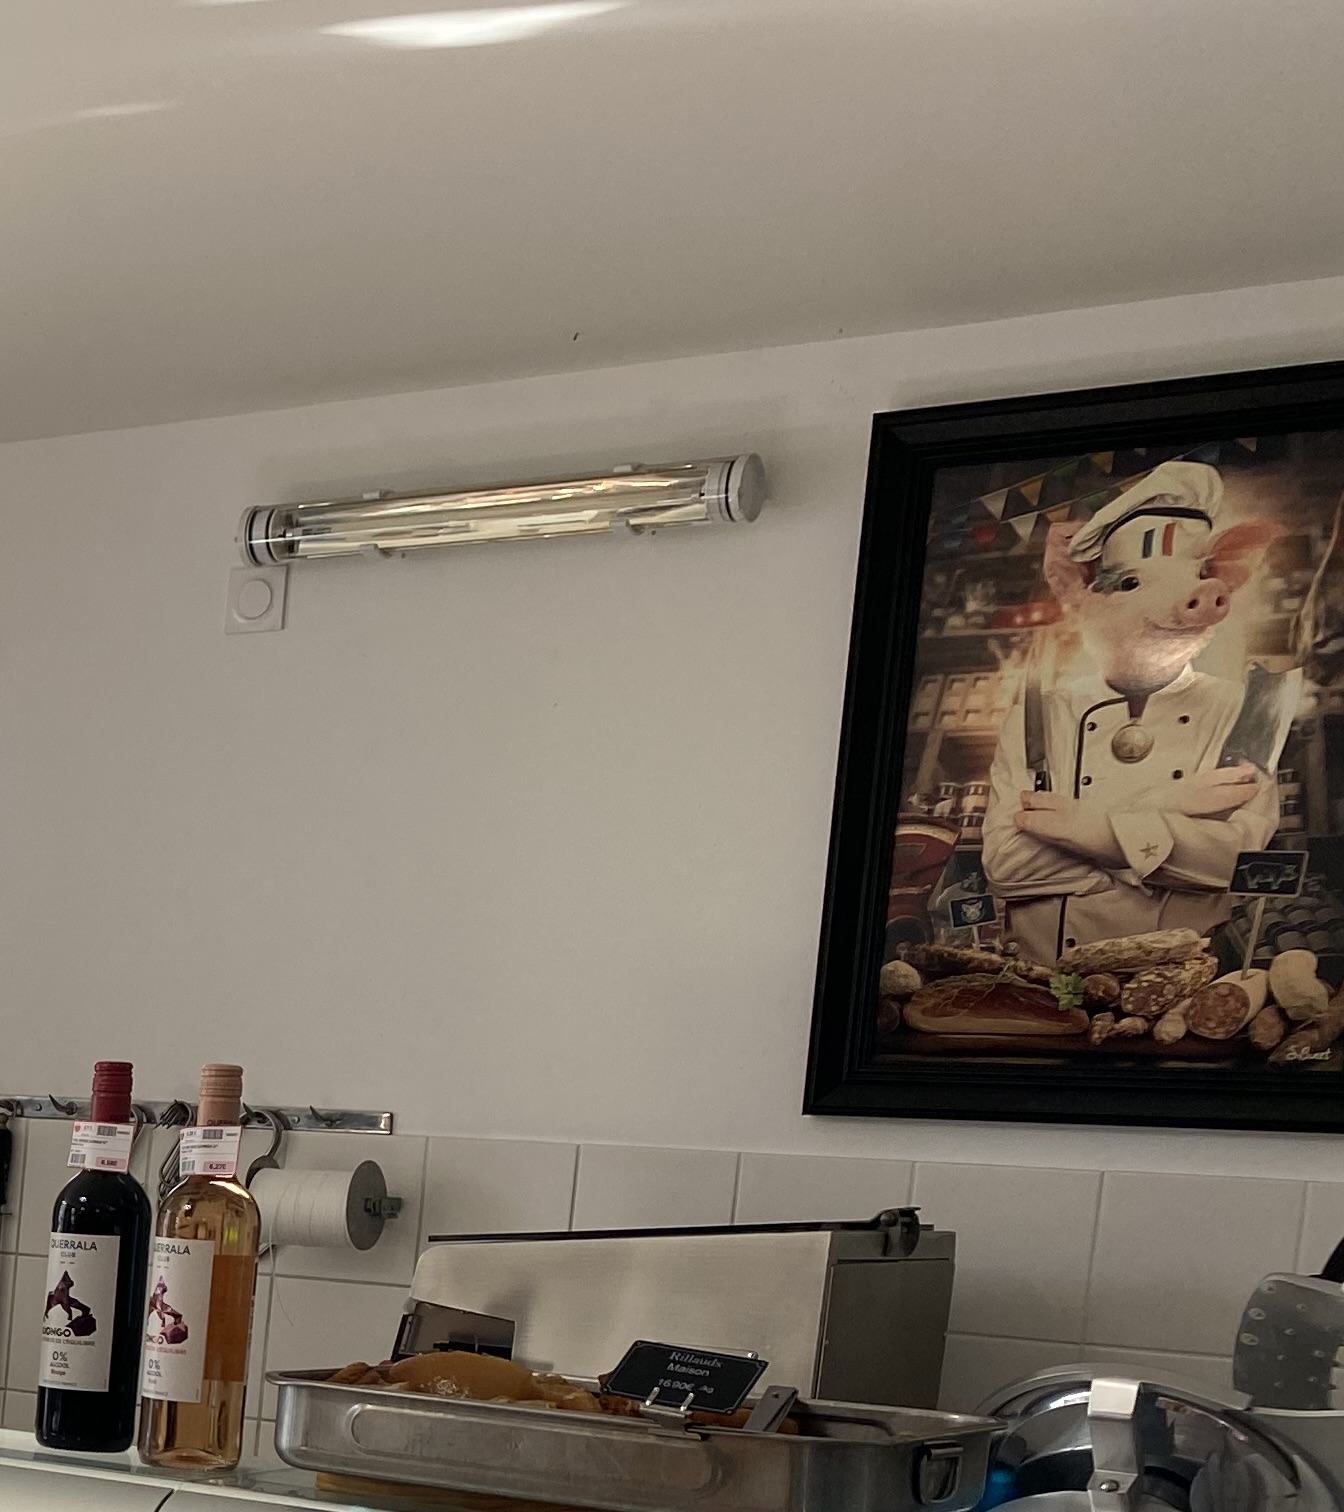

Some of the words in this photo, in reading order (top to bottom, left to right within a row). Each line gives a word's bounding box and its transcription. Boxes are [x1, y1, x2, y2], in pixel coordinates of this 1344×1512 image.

[52, 1350, 68, 1362] 0%
[148, 1358, 161, 1371] 0%
[666, 1362, 711, 1377] Maison
